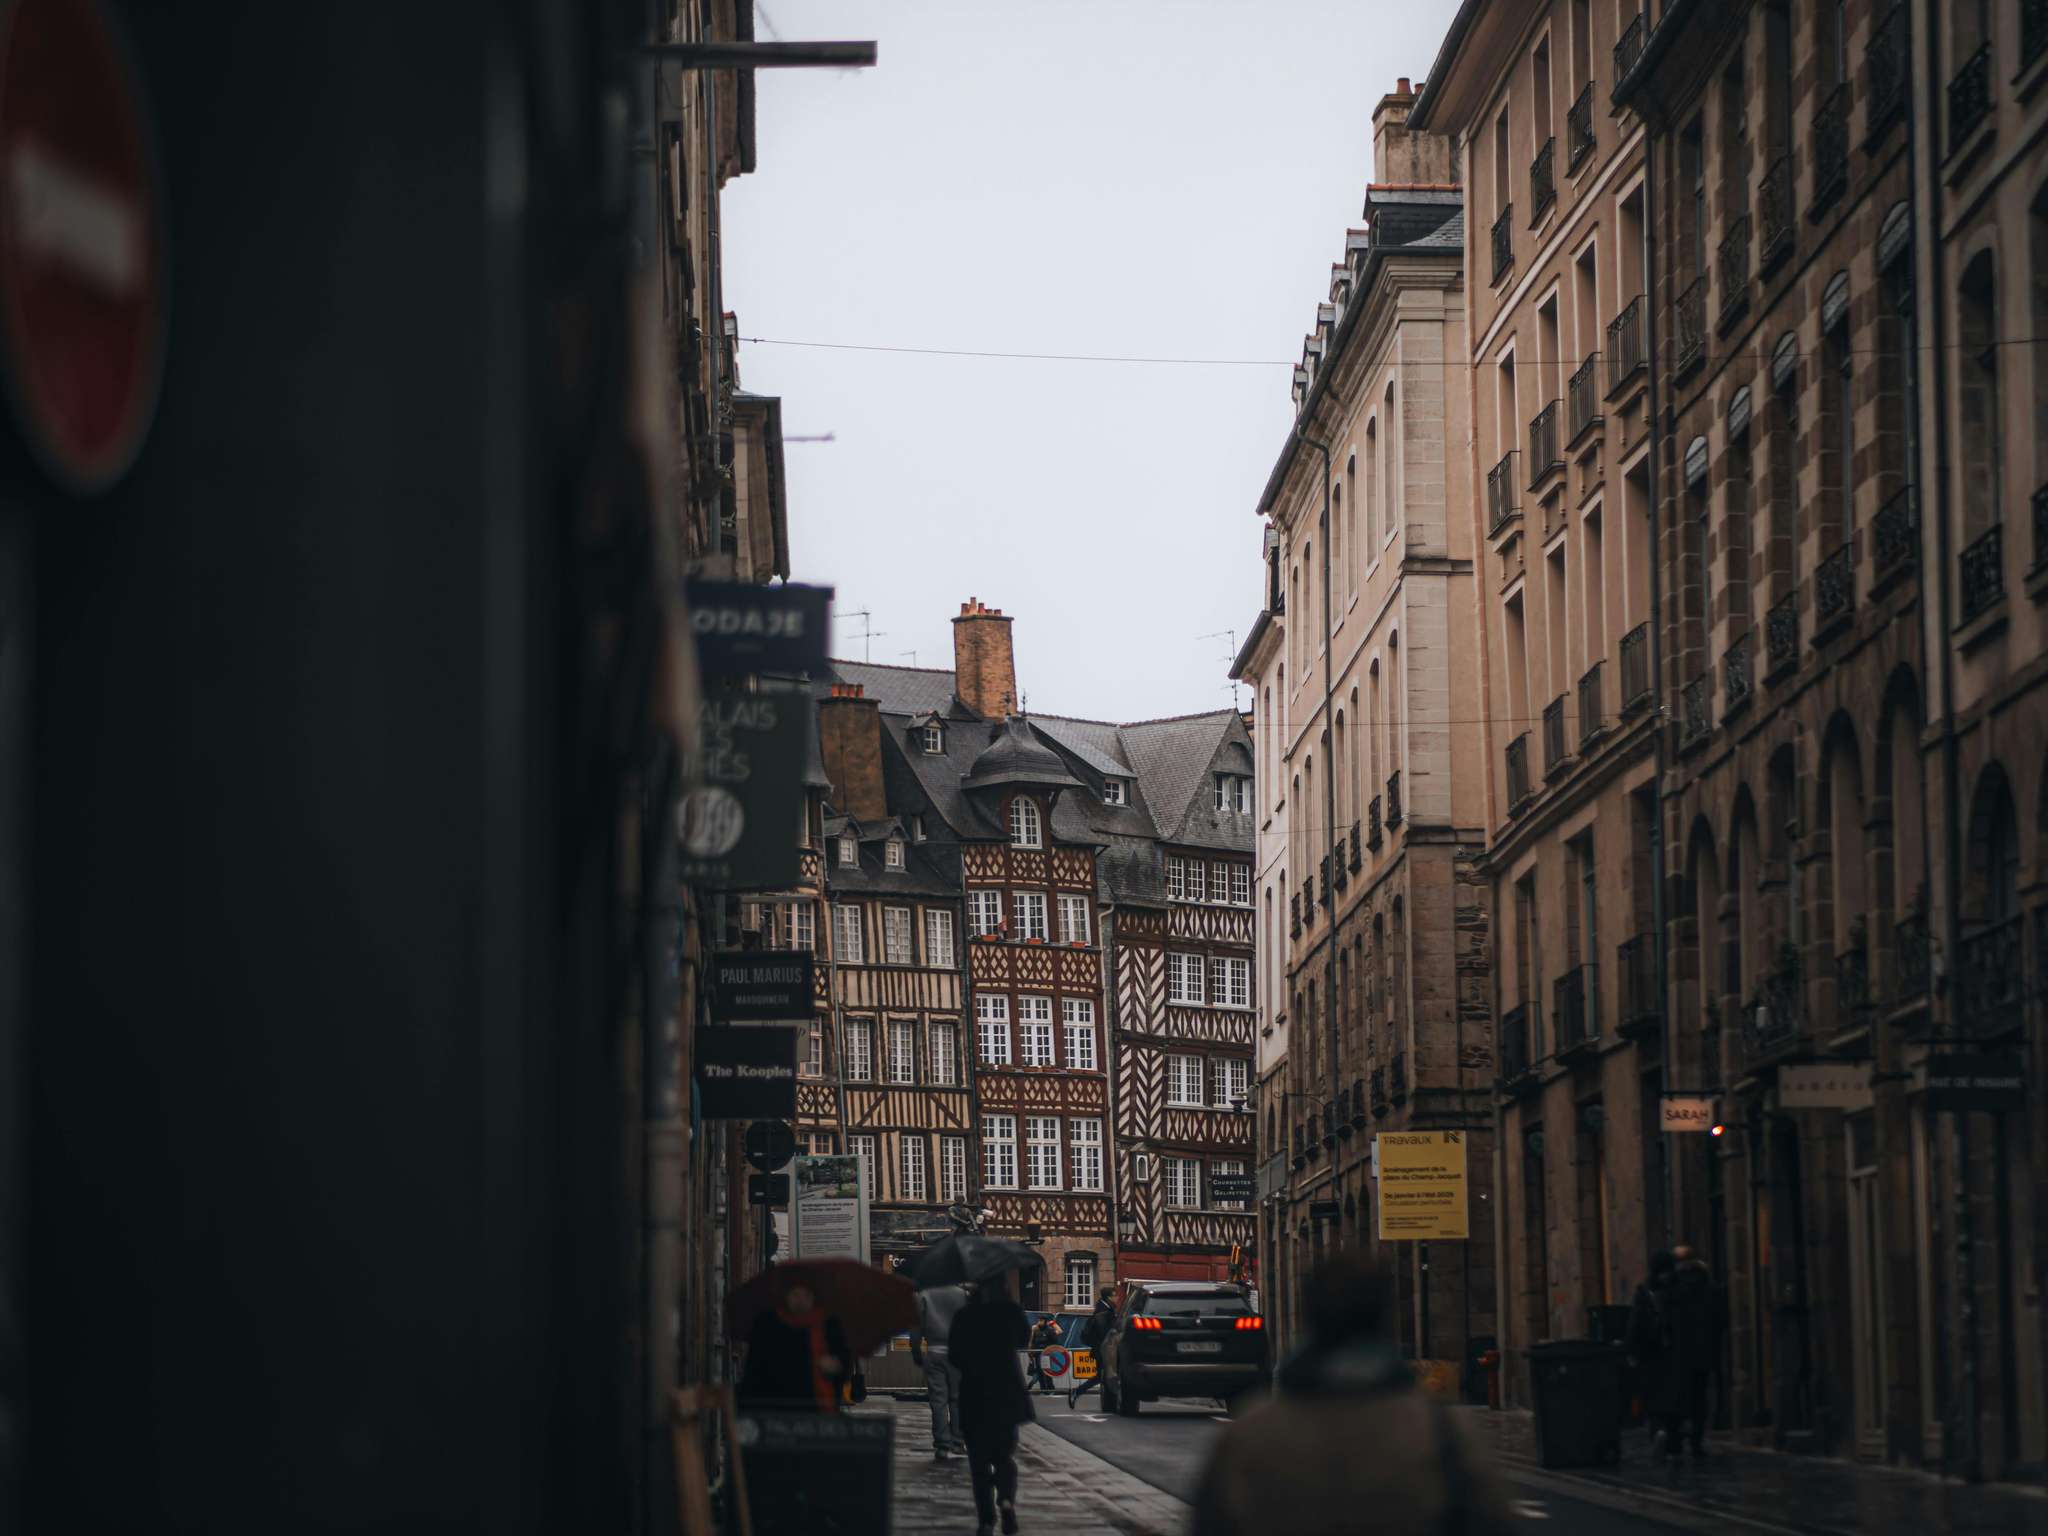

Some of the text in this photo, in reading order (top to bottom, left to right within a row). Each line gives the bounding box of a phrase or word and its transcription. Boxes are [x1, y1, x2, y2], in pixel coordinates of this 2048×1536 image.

[696, 700, 777, 731] ALAIS
[720, 966, 803, 985] PAUL MARIUS
[705, 1064, 793, 1081] The Kooples
[1665, 1109, 1708, 1121] SARAH
